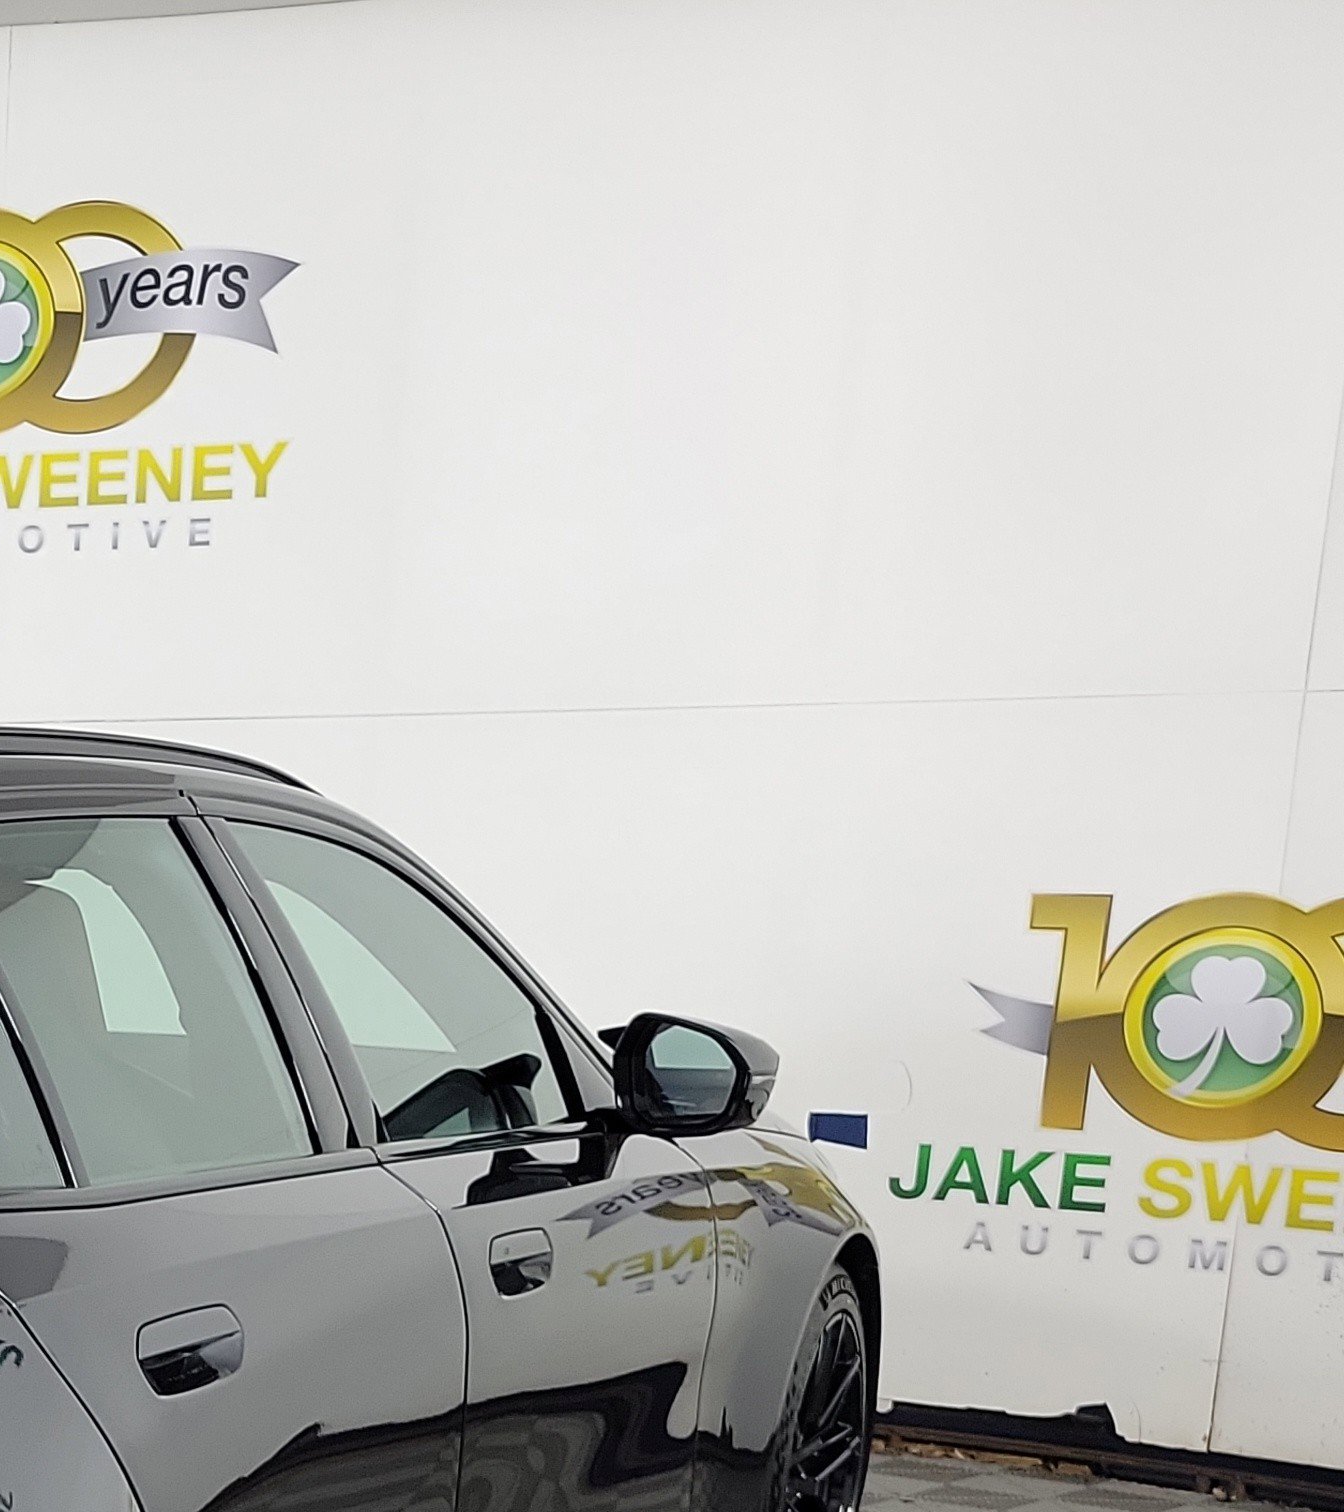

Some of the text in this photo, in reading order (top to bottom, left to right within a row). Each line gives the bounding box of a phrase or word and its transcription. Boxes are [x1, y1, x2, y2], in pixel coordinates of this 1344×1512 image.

[96, 258, 249, 330] years
[889, 1143, 1112, 1213] JAKE
[1137, 1158, 1344, 1232] SWE
